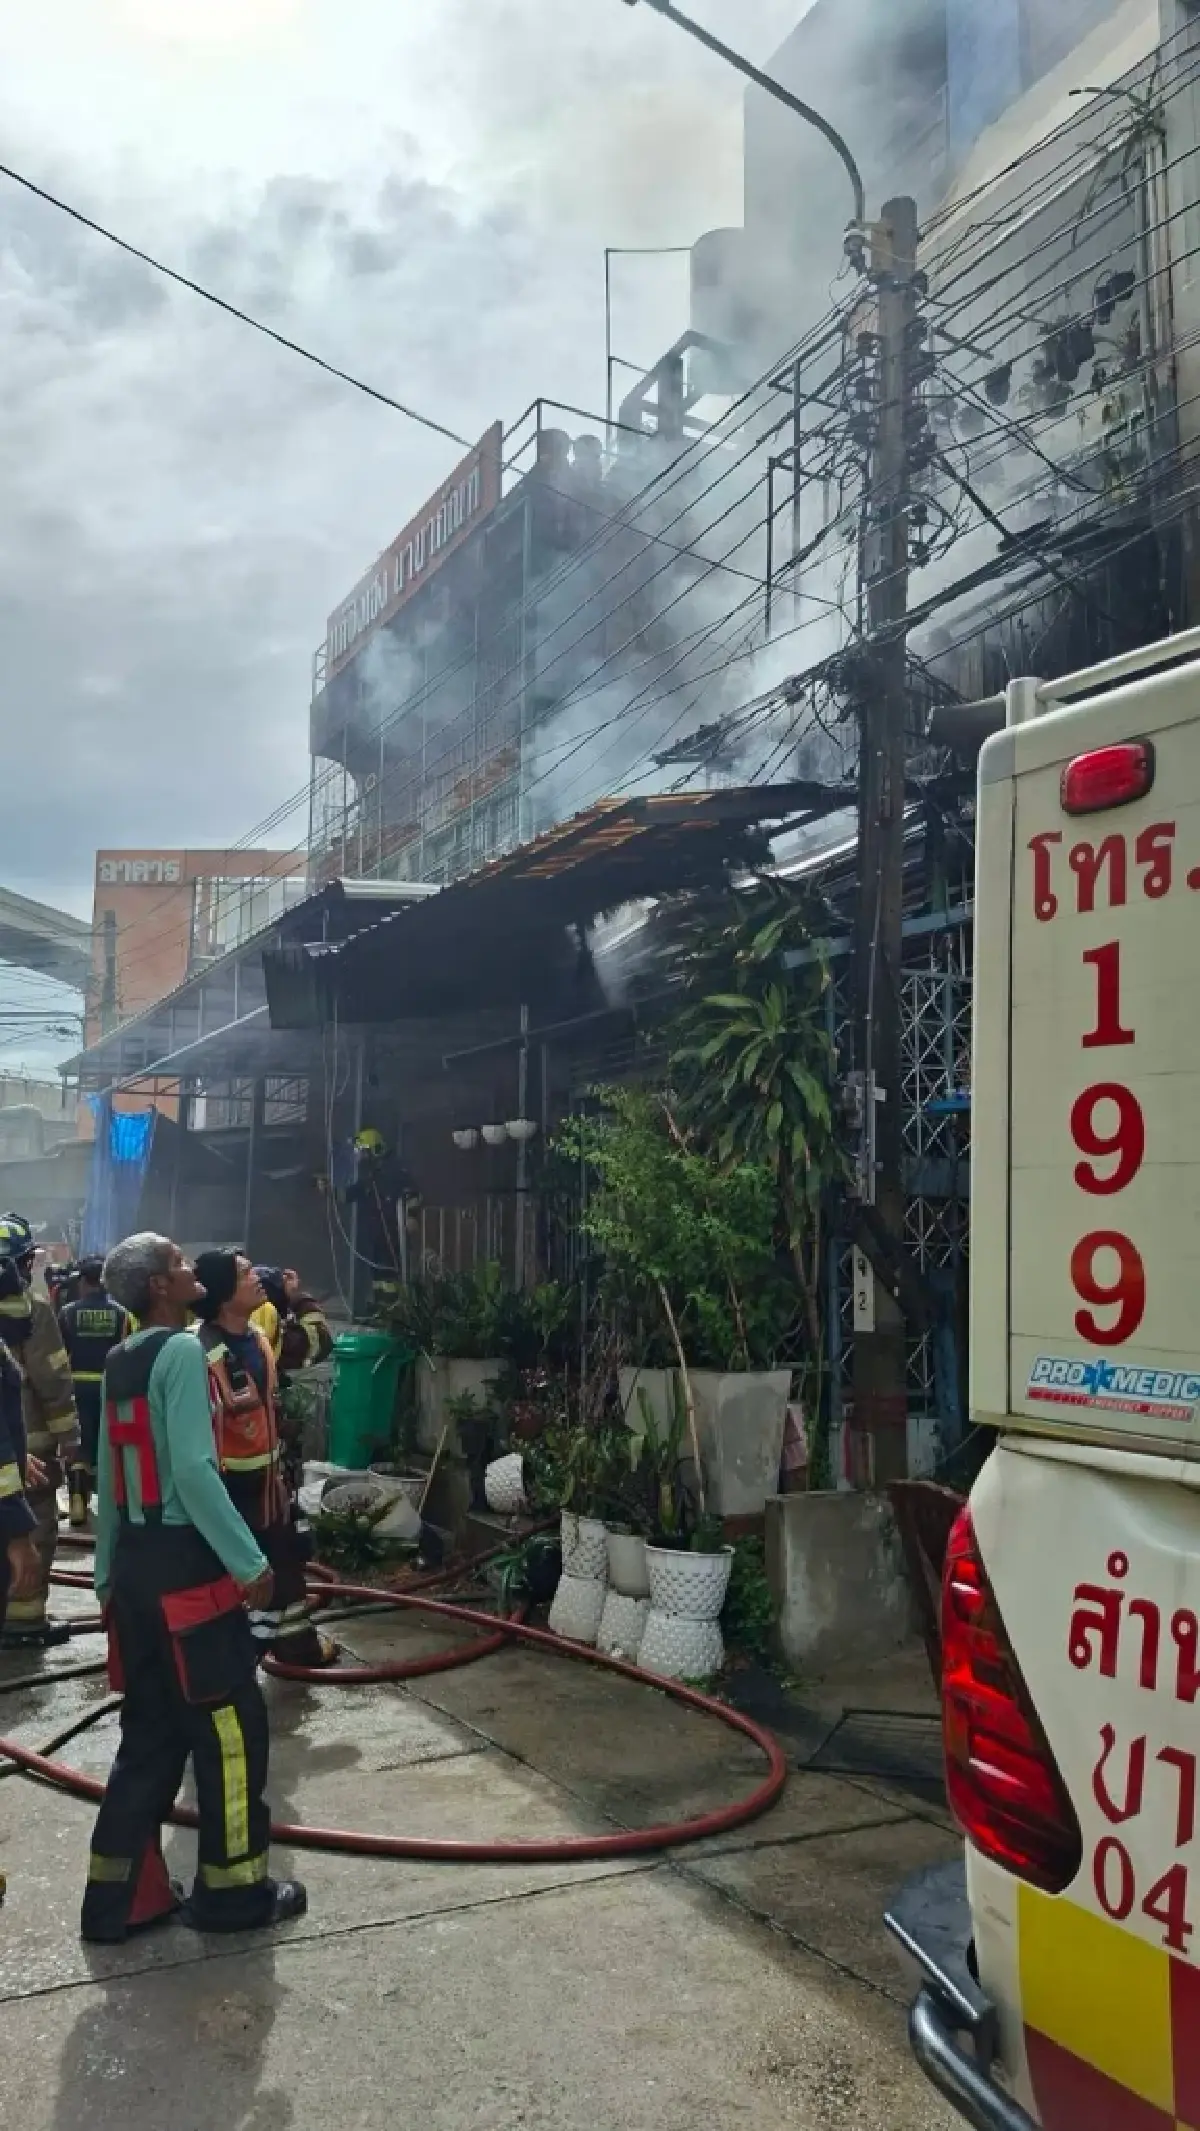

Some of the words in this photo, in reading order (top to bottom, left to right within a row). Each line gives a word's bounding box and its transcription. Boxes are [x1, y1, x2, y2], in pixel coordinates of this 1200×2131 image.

[99, 858, 181, 882] อาคาร
[1027, 820, 1200, 921] โทร.
[1031, 1358, 1085, 1385] PRO
[1110, 1368, 1200, 1399] MEDIC
